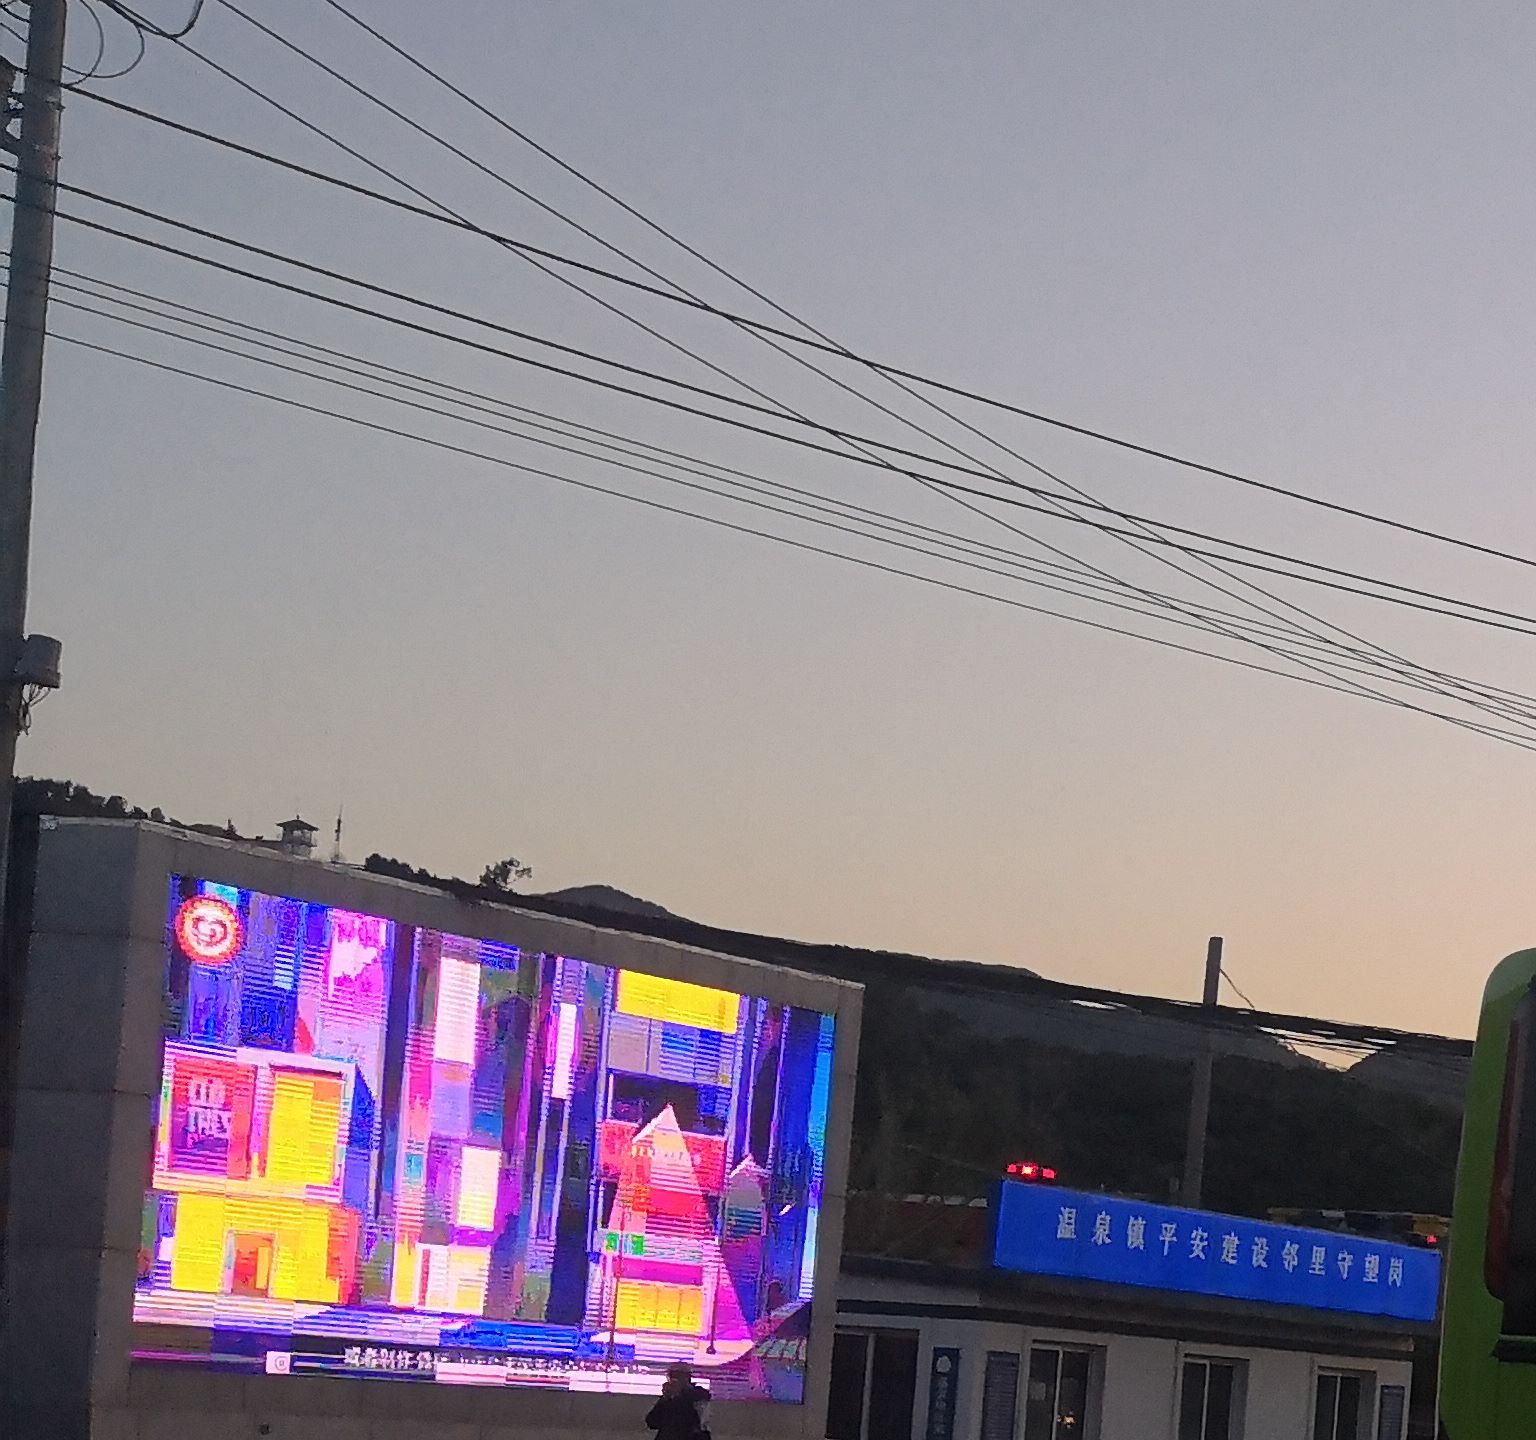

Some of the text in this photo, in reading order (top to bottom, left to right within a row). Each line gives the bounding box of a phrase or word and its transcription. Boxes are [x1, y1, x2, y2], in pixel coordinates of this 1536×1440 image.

[1056, 1206, 1405, 1288] 温泉镇平安建设邻里守望岗
